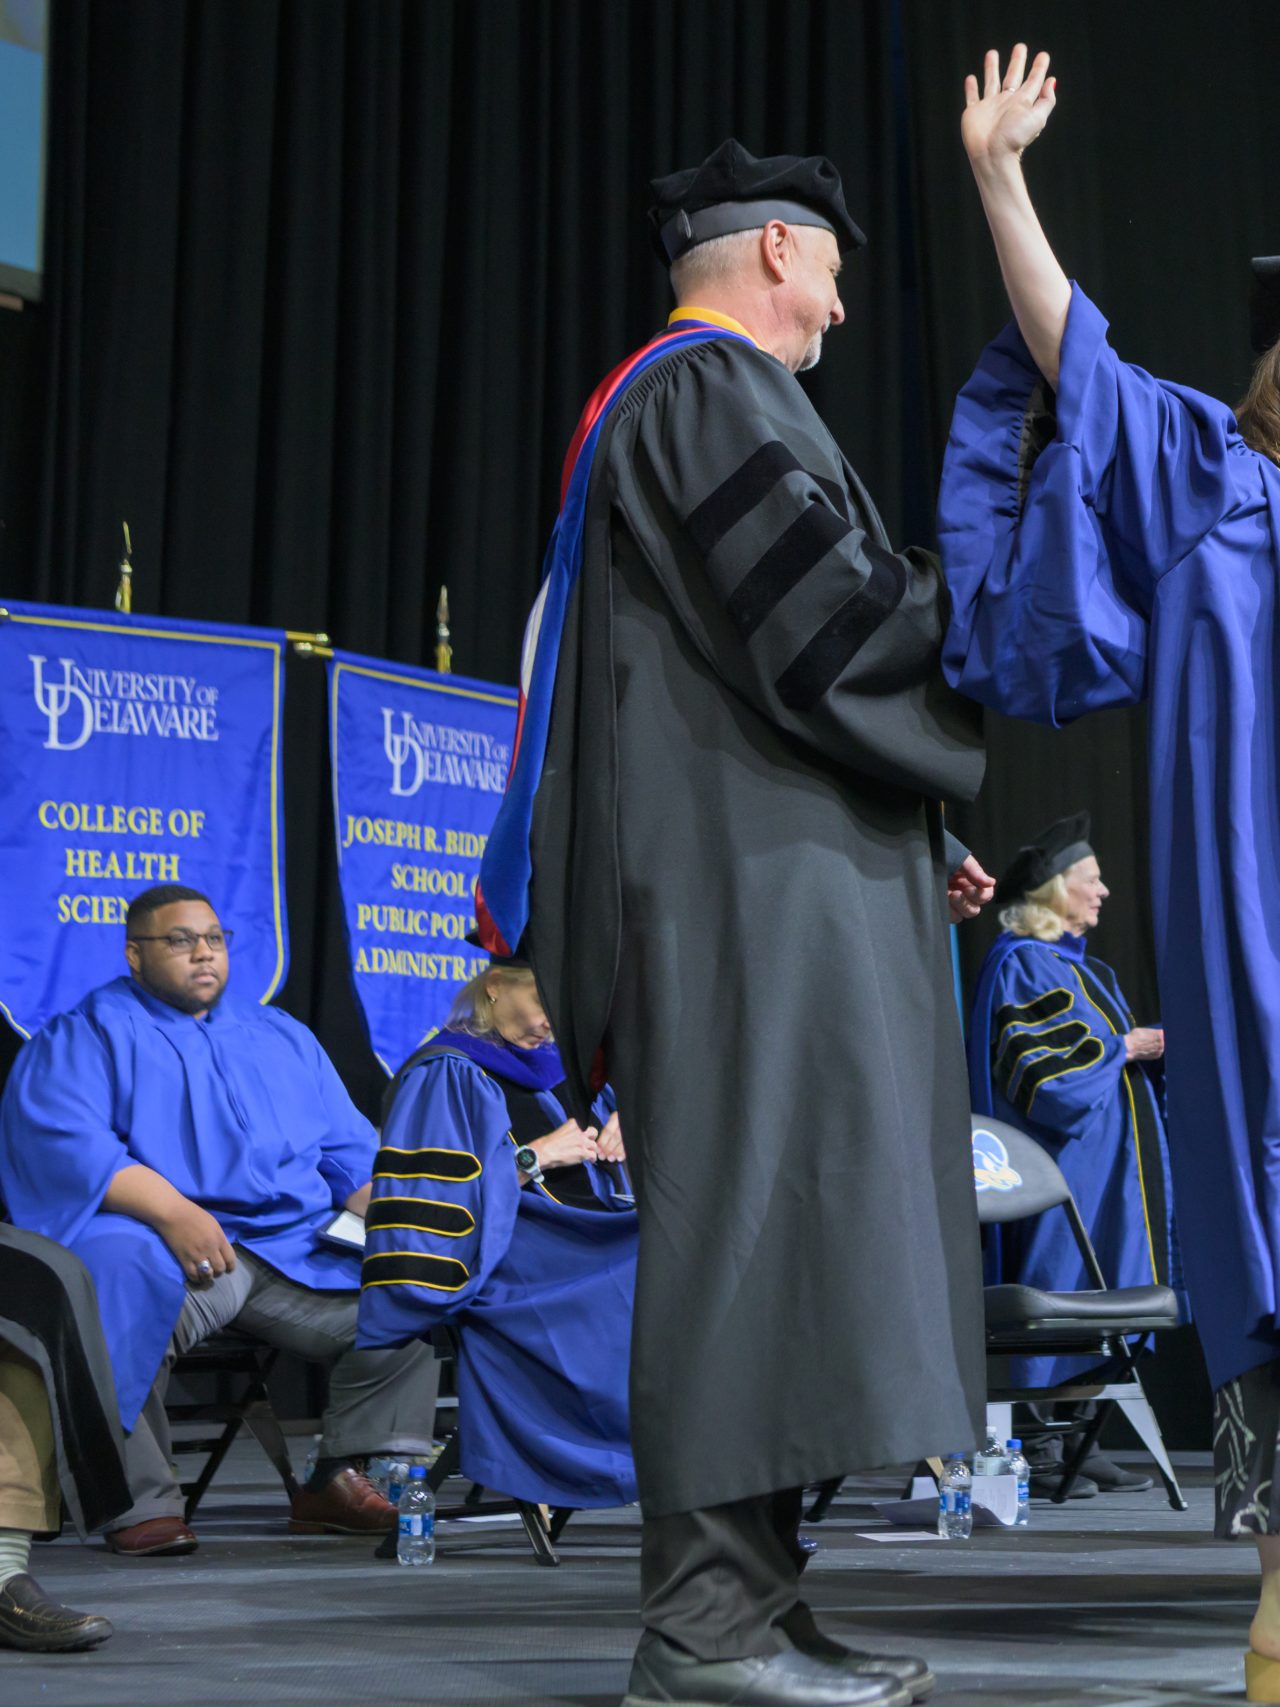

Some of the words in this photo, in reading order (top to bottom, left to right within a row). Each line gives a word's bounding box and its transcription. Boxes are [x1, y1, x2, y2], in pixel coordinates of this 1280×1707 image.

[38, 801, 164, 835] COLLEGE
[168, 809, 205, 838] OF
[343, 815, 421, 850] JOSEPH
[424, 826, 443, 853] R.
[65, 848, 180, 881] HEALTH
[391, 863, 468, 898] SCHOOL
[356, 903, 428, 936] PUBLIC
